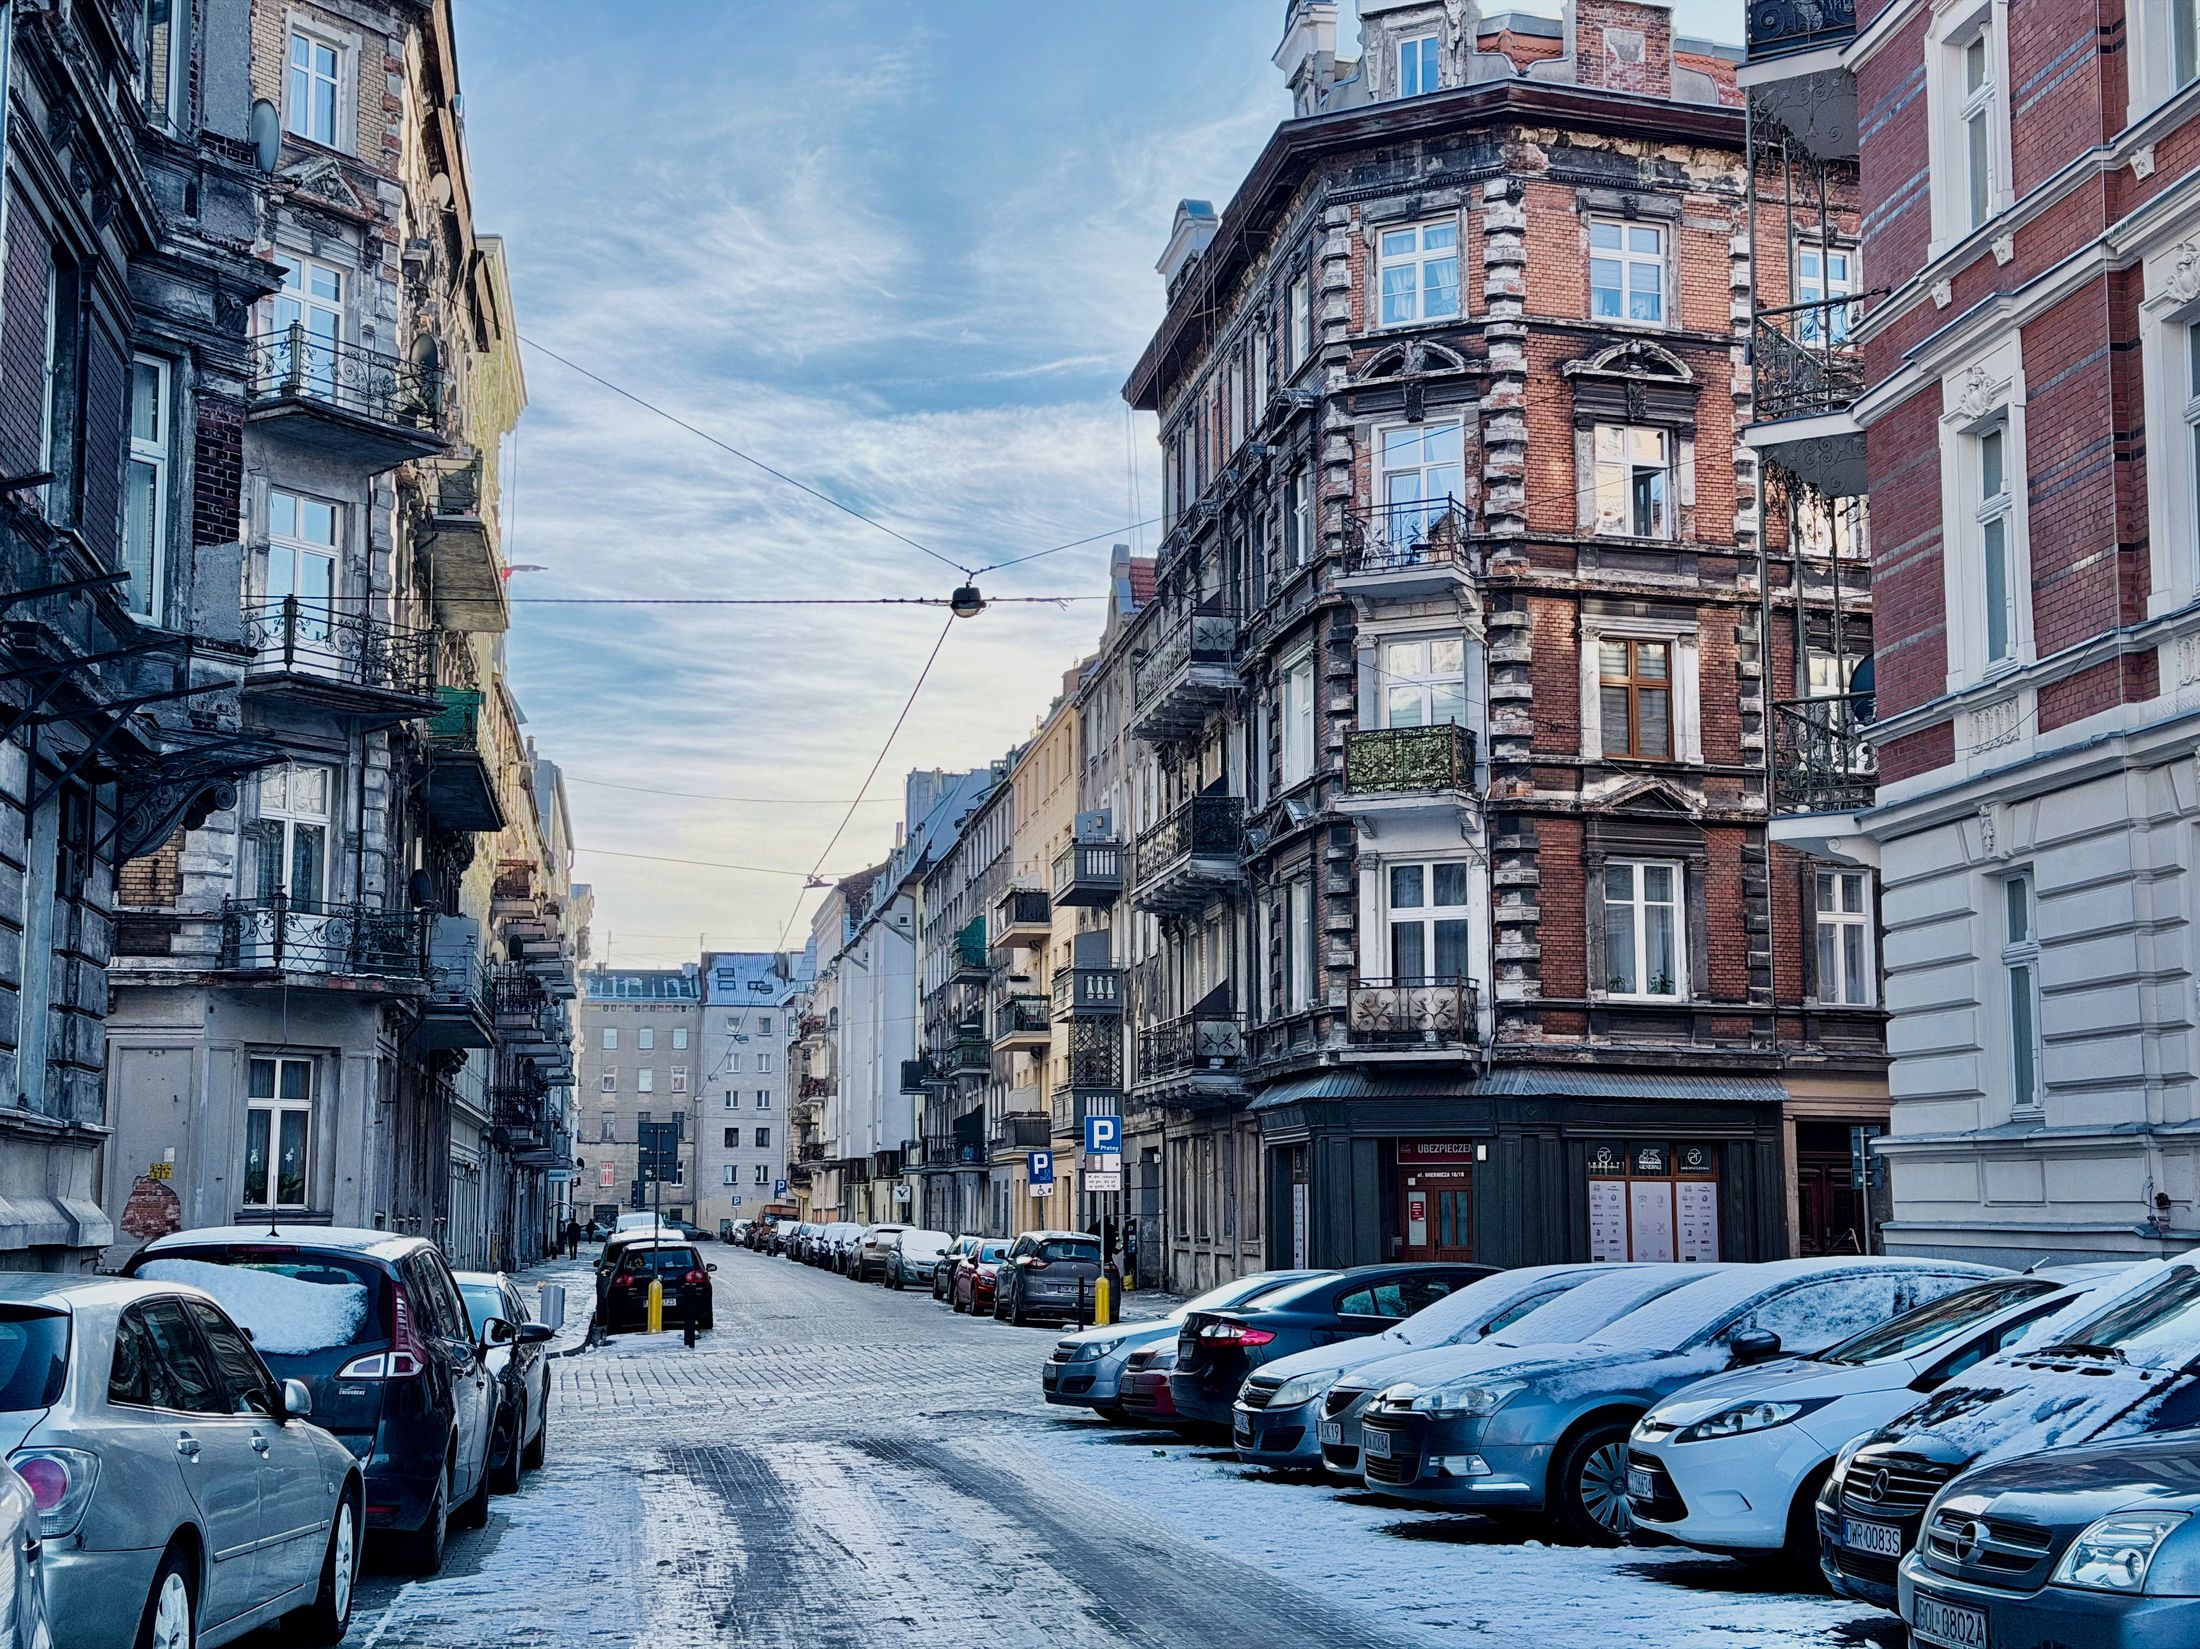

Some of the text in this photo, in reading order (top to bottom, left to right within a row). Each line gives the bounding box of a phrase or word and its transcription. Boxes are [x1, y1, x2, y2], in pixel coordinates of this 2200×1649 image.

[1093, 1120, 1114, 1149] P
[1034, 1153, 1048, 1175] P
[1847, 1521, 1900, 1555] DWR 0083S
[1942, 1607, 1986, 1648] 0802A
